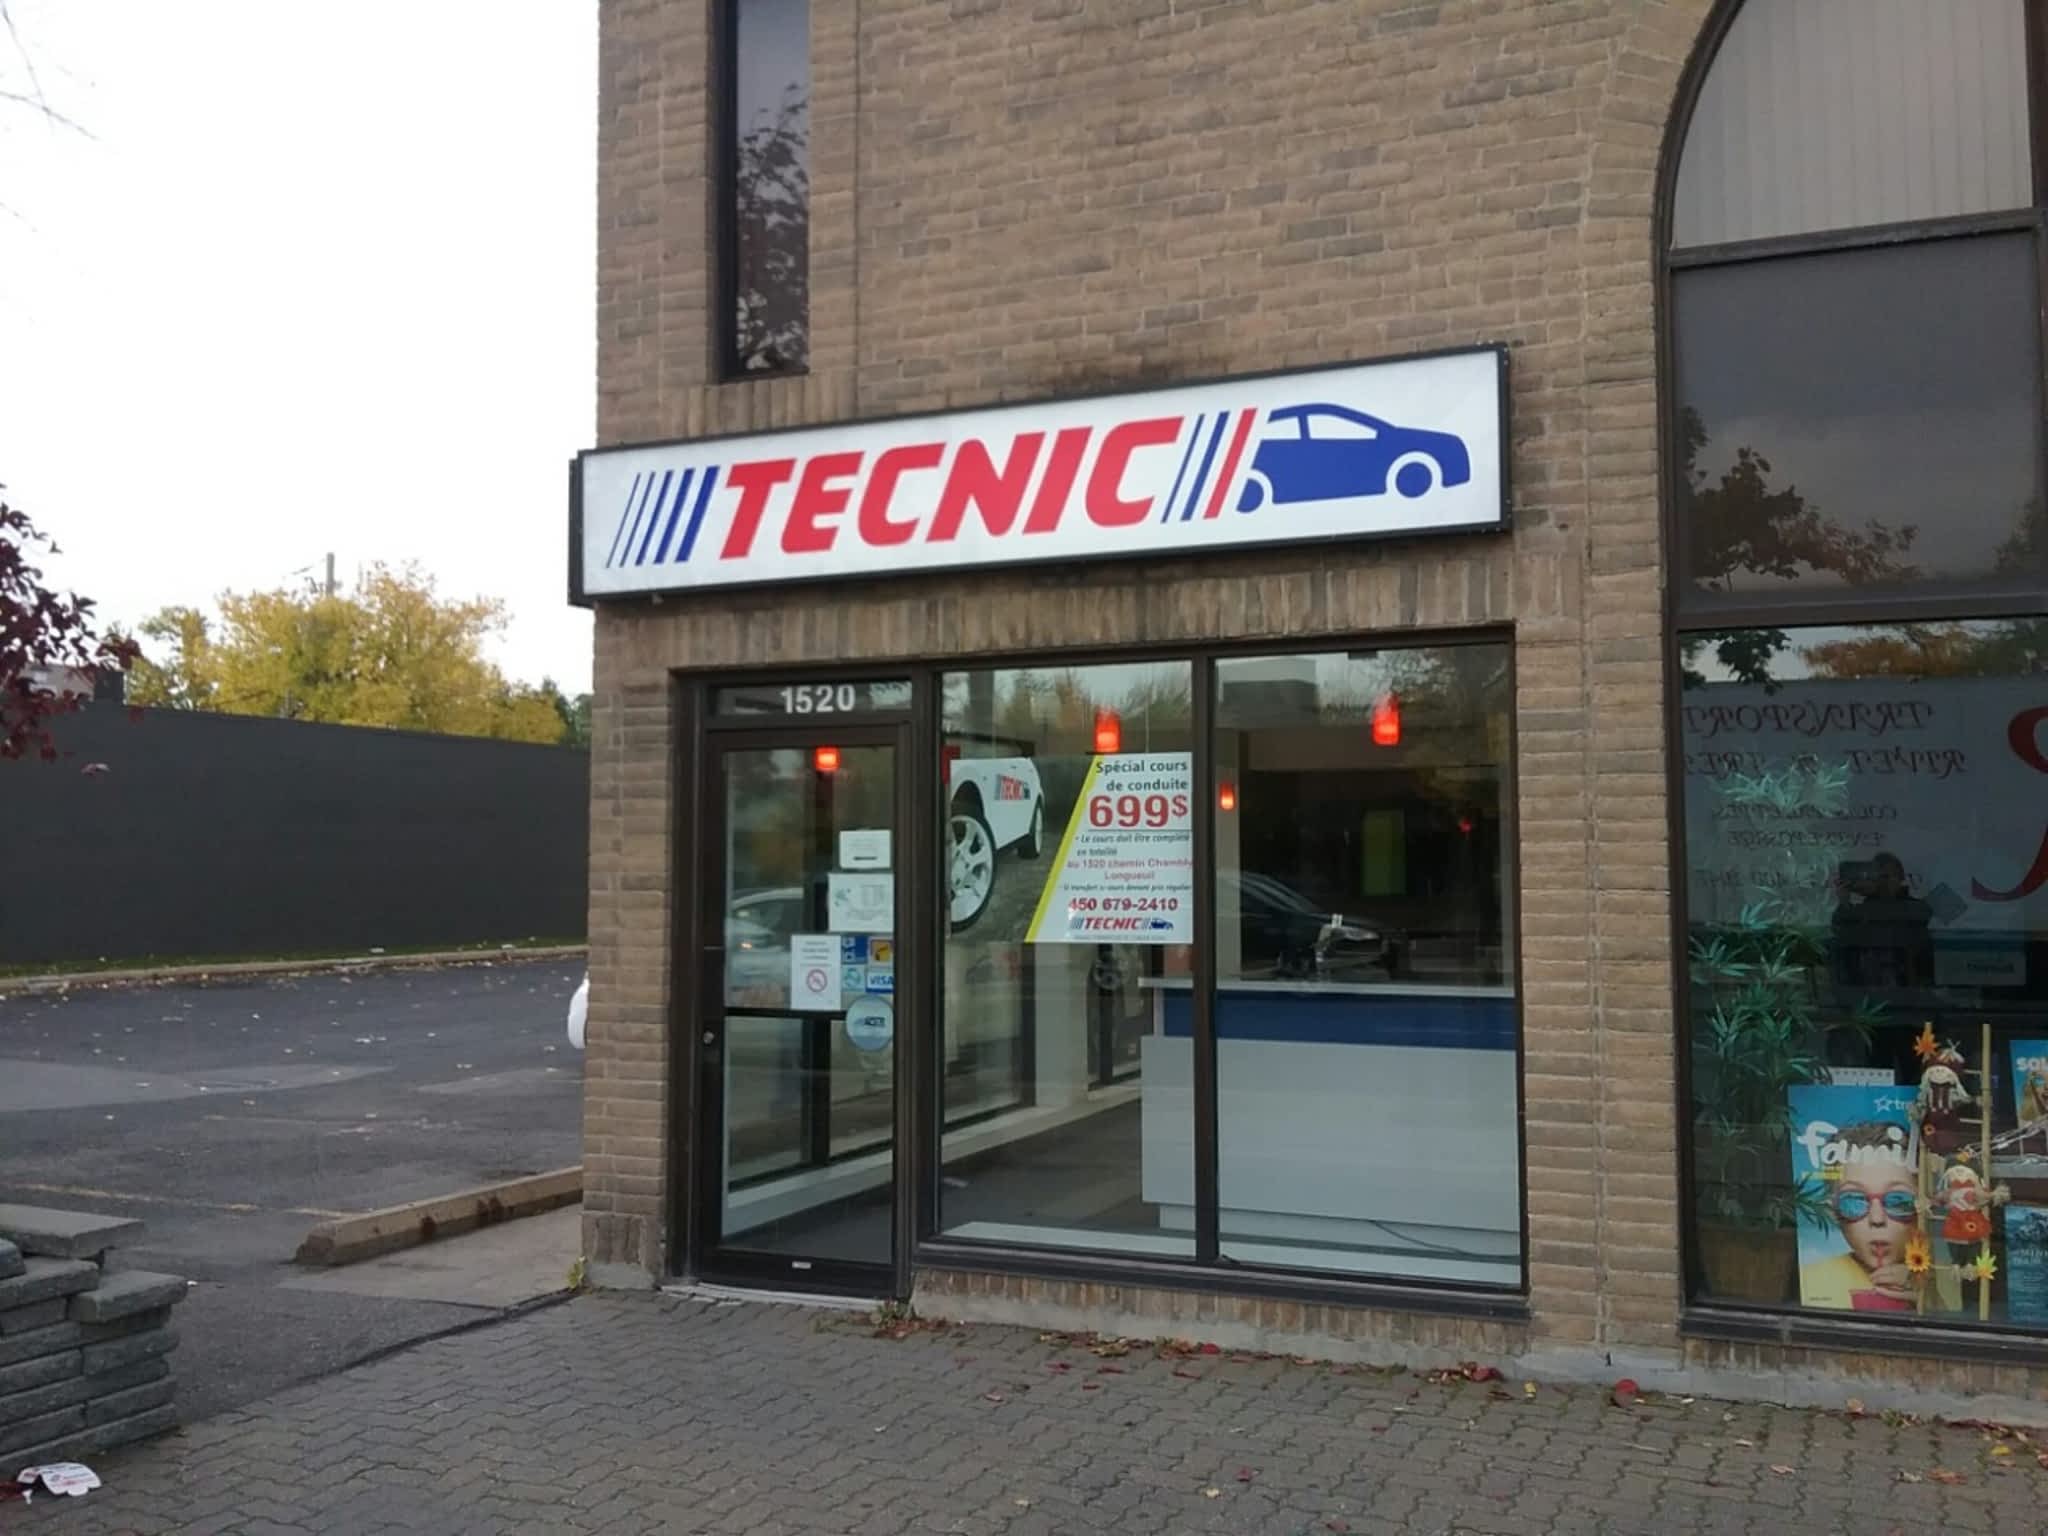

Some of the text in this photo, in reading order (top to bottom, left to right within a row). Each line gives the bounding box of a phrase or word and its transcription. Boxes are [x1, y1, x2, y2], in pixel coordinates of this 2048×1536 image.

[720, 416, 1183, 558] TECNIC
[780, 684, 857, 714] 1520
[1096, 760, 1188, 775] Spécial cours
[1106, 778, 1188, 791] de conduite
[1090, 795, 1188, 827] 699$
[1069, 897, 1178, 911] 450 679-2410
[1084, 917, 1143, 930] TECNIC
[870, 975, 894, 985] VISA
